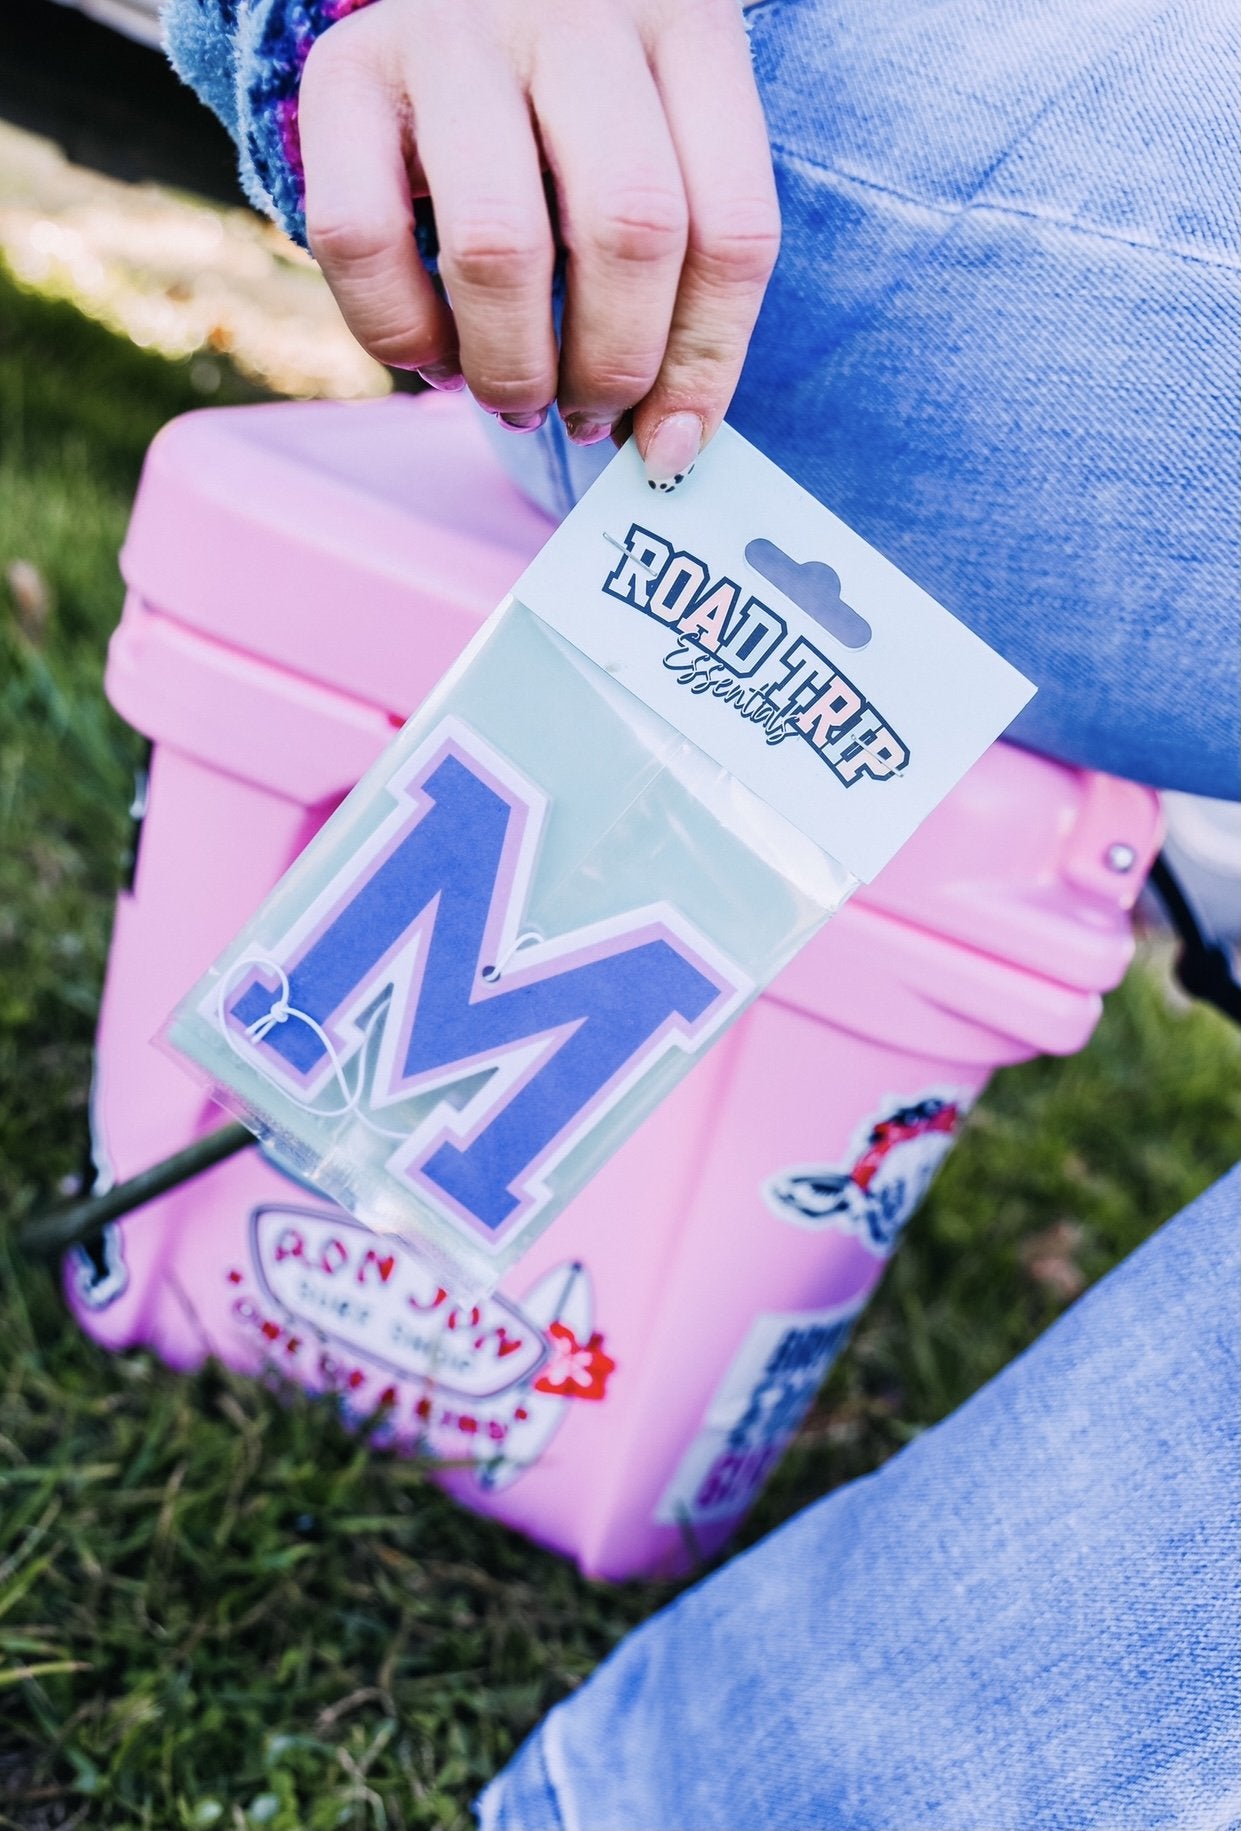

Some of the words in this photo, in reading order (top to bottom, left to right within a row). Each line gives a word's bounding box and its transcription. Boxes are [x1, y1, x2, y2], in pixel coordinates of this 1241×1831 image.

[602, 523, 788, 679] ROAD
[764, 635, 911, 788] TRIP
[663, 632, 800, 746] Essentials
[220, 740, 737, 1240] M
